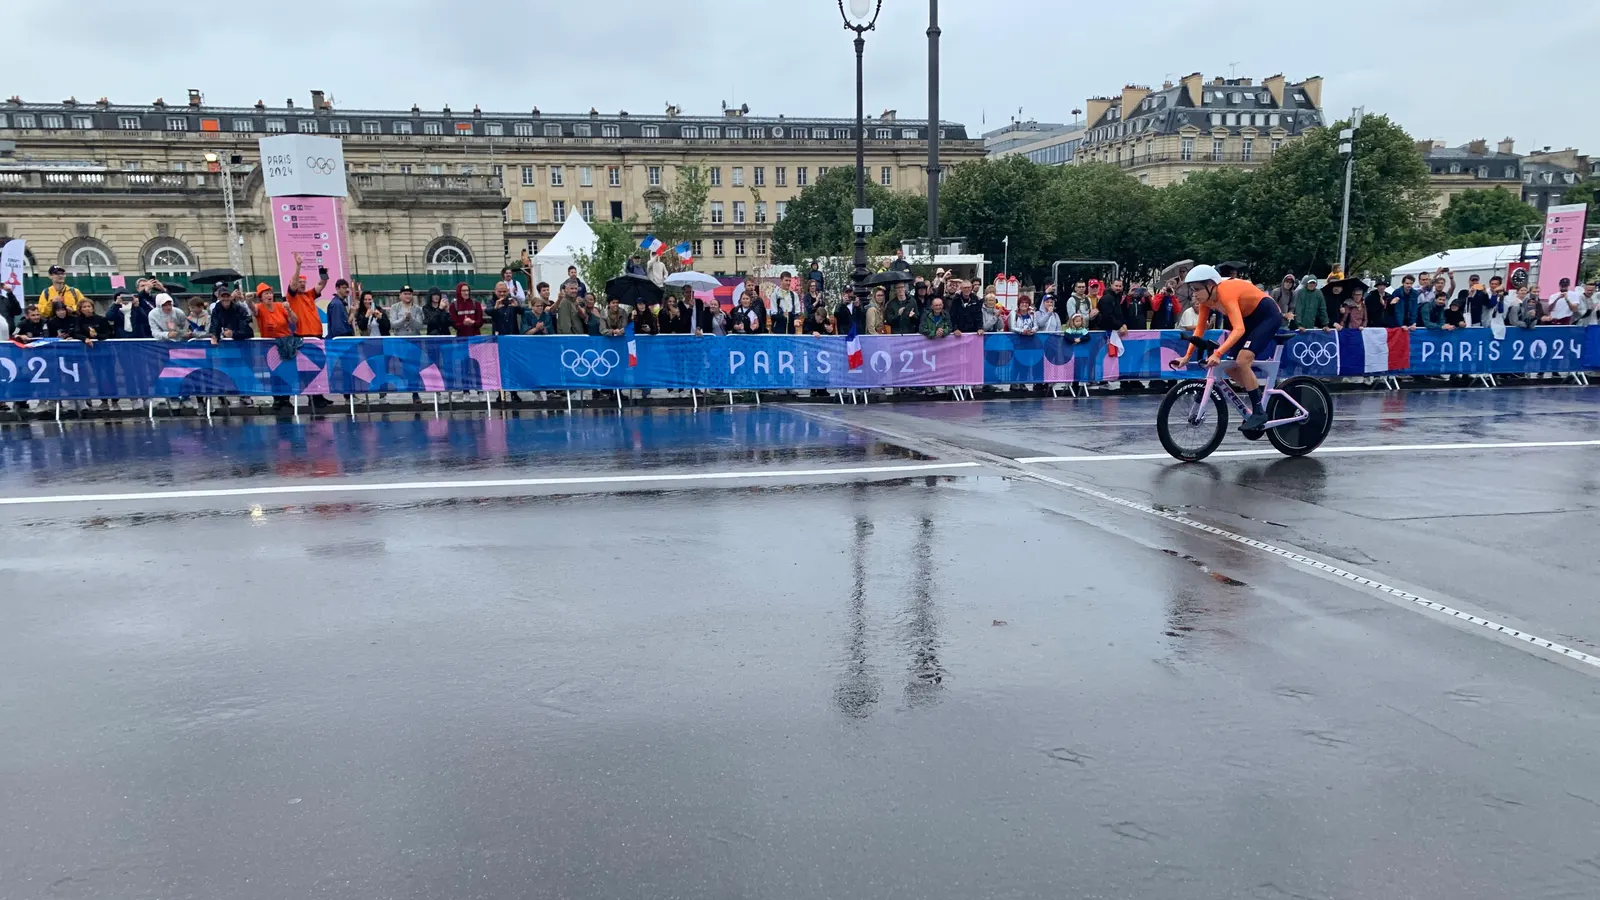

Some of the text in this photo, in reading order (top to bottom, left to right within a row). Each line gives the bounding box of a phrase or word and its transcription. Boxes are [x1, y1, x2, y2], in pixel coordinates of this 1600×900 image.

[269, 166, 293, 177] 2024
[1512, 339, 1582, 361] 2024
[847, 350, 936, 373] 024
